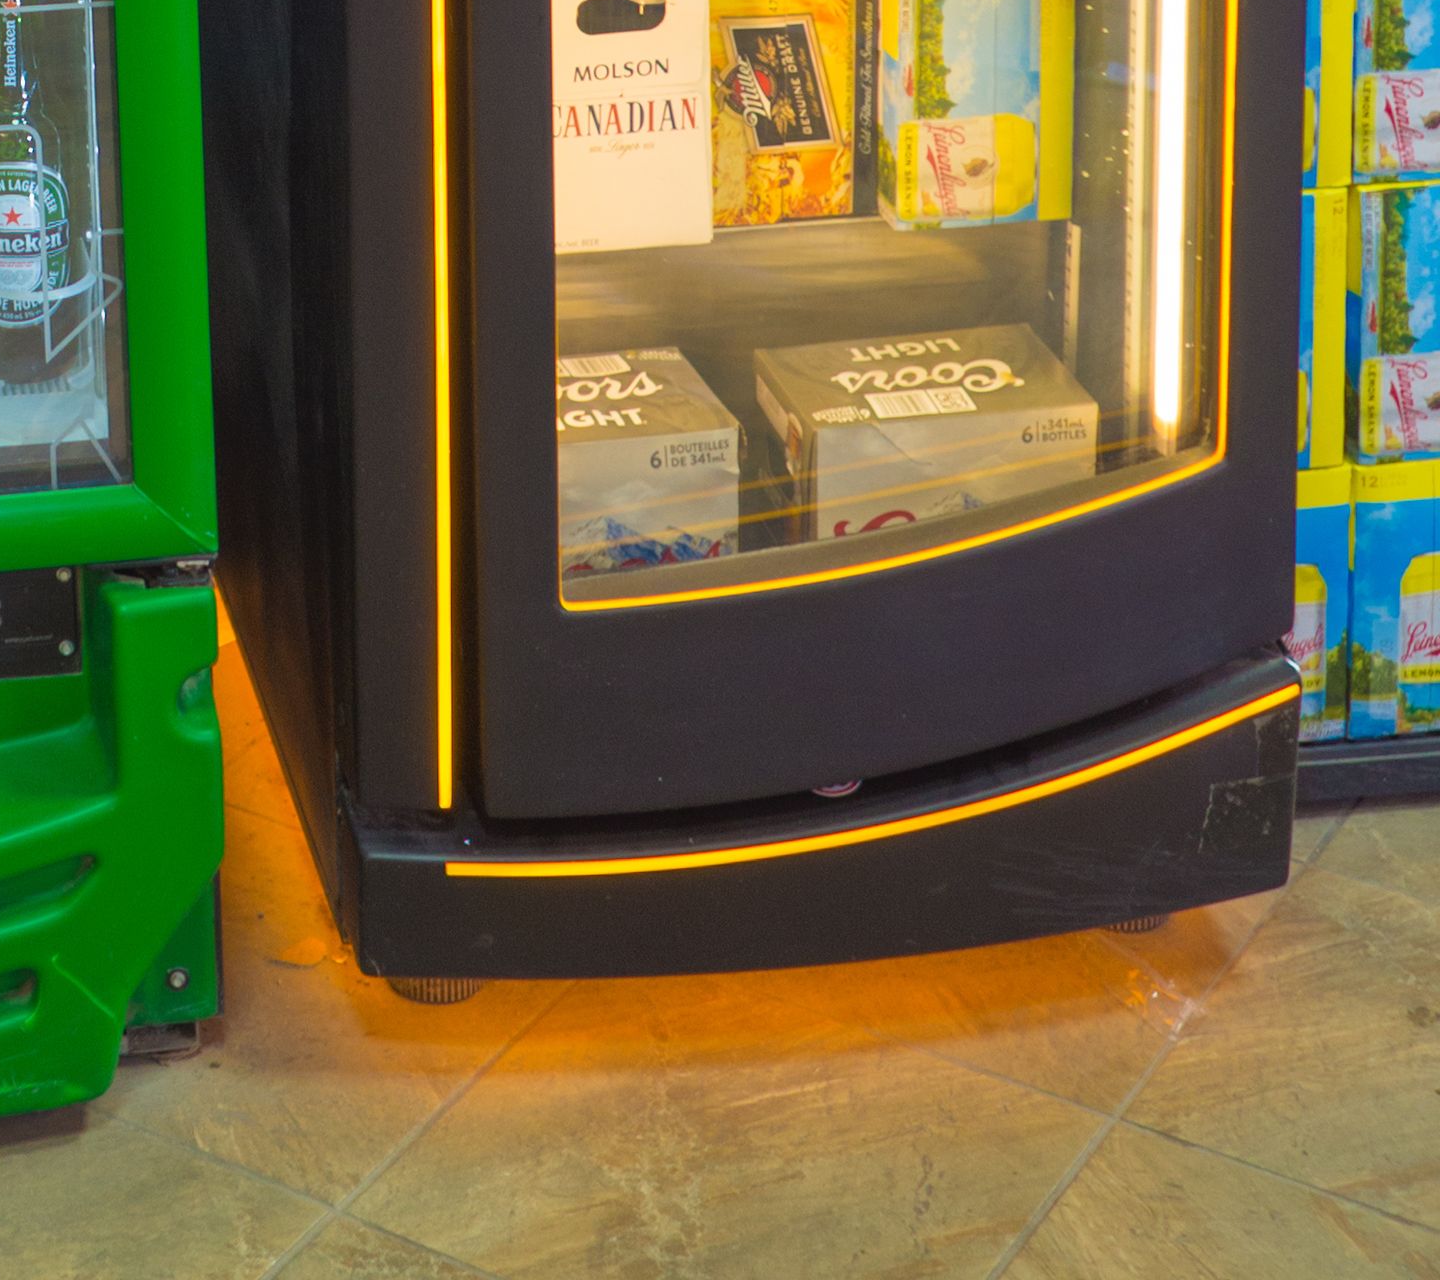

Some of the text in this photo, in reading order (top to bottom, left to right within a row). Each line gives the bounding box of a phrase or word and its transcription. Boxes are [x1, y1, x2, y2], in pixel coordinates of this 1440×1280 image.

[3, 19, 17, 88] Heineken
[573, 58, 669, 83] MOLSON
[737, 53, 772, 127] Miller
[791, 77, 813, 135] GENUINE
[849, 337, 962, 363] LIGHT
[830, 357, 1025, 394] Coors
[1021, 425, 1033, 444] 6
[1042, 428, 1087, 442] BOTTLES
[650, 439, 729, 469] 6 BOUTEILLES
[671, 455, 687, 467] DE
[1360, 475, 1378, 489] 12
